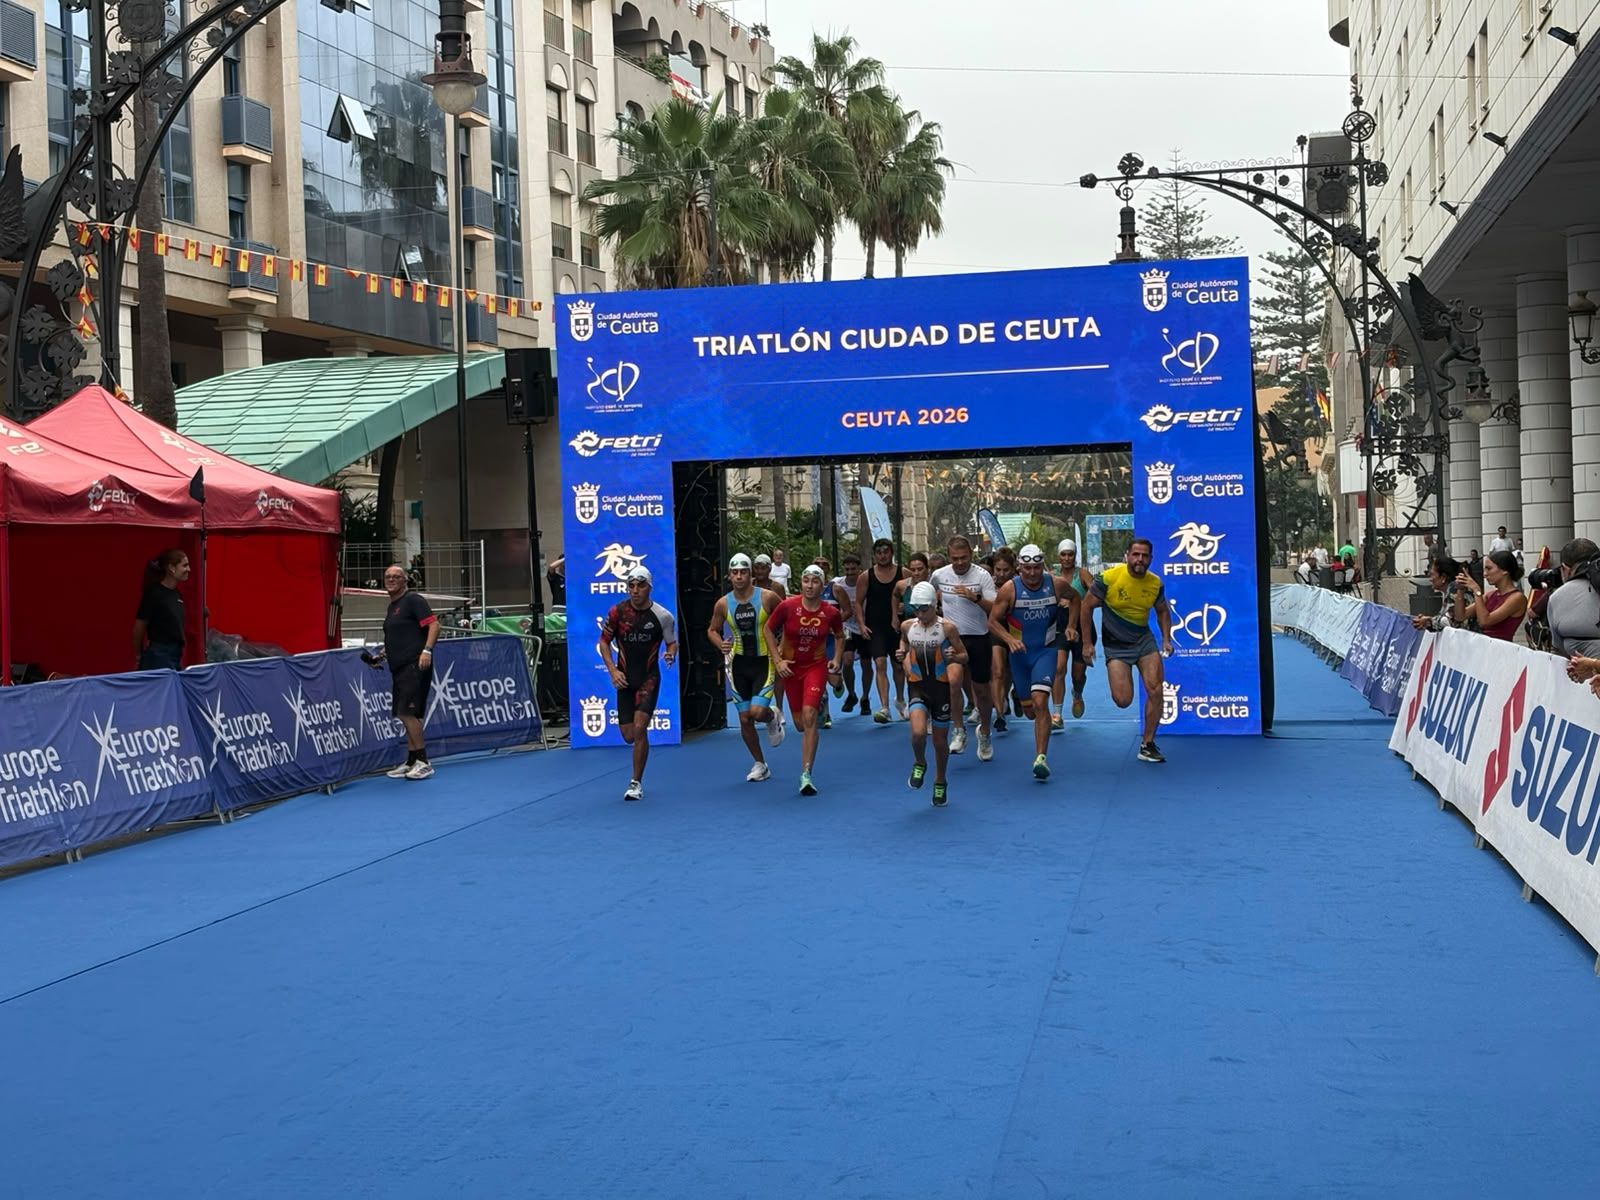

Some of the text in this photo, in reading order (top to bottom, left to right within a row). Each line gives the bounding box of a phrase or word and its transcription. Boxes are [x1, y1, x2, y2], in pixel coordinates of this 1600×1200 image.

[1171, 279, 1239, 289] Ciudad Autónoma
[1171, 287, 1239, 305] de Ceuta
[597, 311, 658, 322] Ciudad Autónoma
[597, 319, 659, 335] de Ceuta
[693, 316, 1101, 357] TRIATLÓN CIUDAD DE CEUTA
[841, 406, 969, 429] CEUTA 2026
[1204, 473, 1243, 482] Autónoma
[601, 493, 663, 503] Ciudad Autónoma
[1176, 481, 1244, 498] de Ceuta
[601, 502, 664, 518] de Ceuta
[1163, 561, 1230, 576] FETRICE
[590, 581, 628, 595] FETR
[445, 676, 516, 701] Europe
[1181, 694, 1249, 704] Ciudad Autónoma
[300, 700, 342, 726] Europe
[448, 699, 537, 728] Triathlon
[1182, 703, 1249, 719] de Ceuta
[1420, 660, 1488, 766] SUZUKI
[219, 711, 273, 741] Europe
[109, 724, 181, 760] Europe
[307, 725, 359, 756] Triathlon
[0, 746, 62, 783] urope
[225, 738, 294, 773] Triathlon
[117, 754, 207, 796] Triathlon
